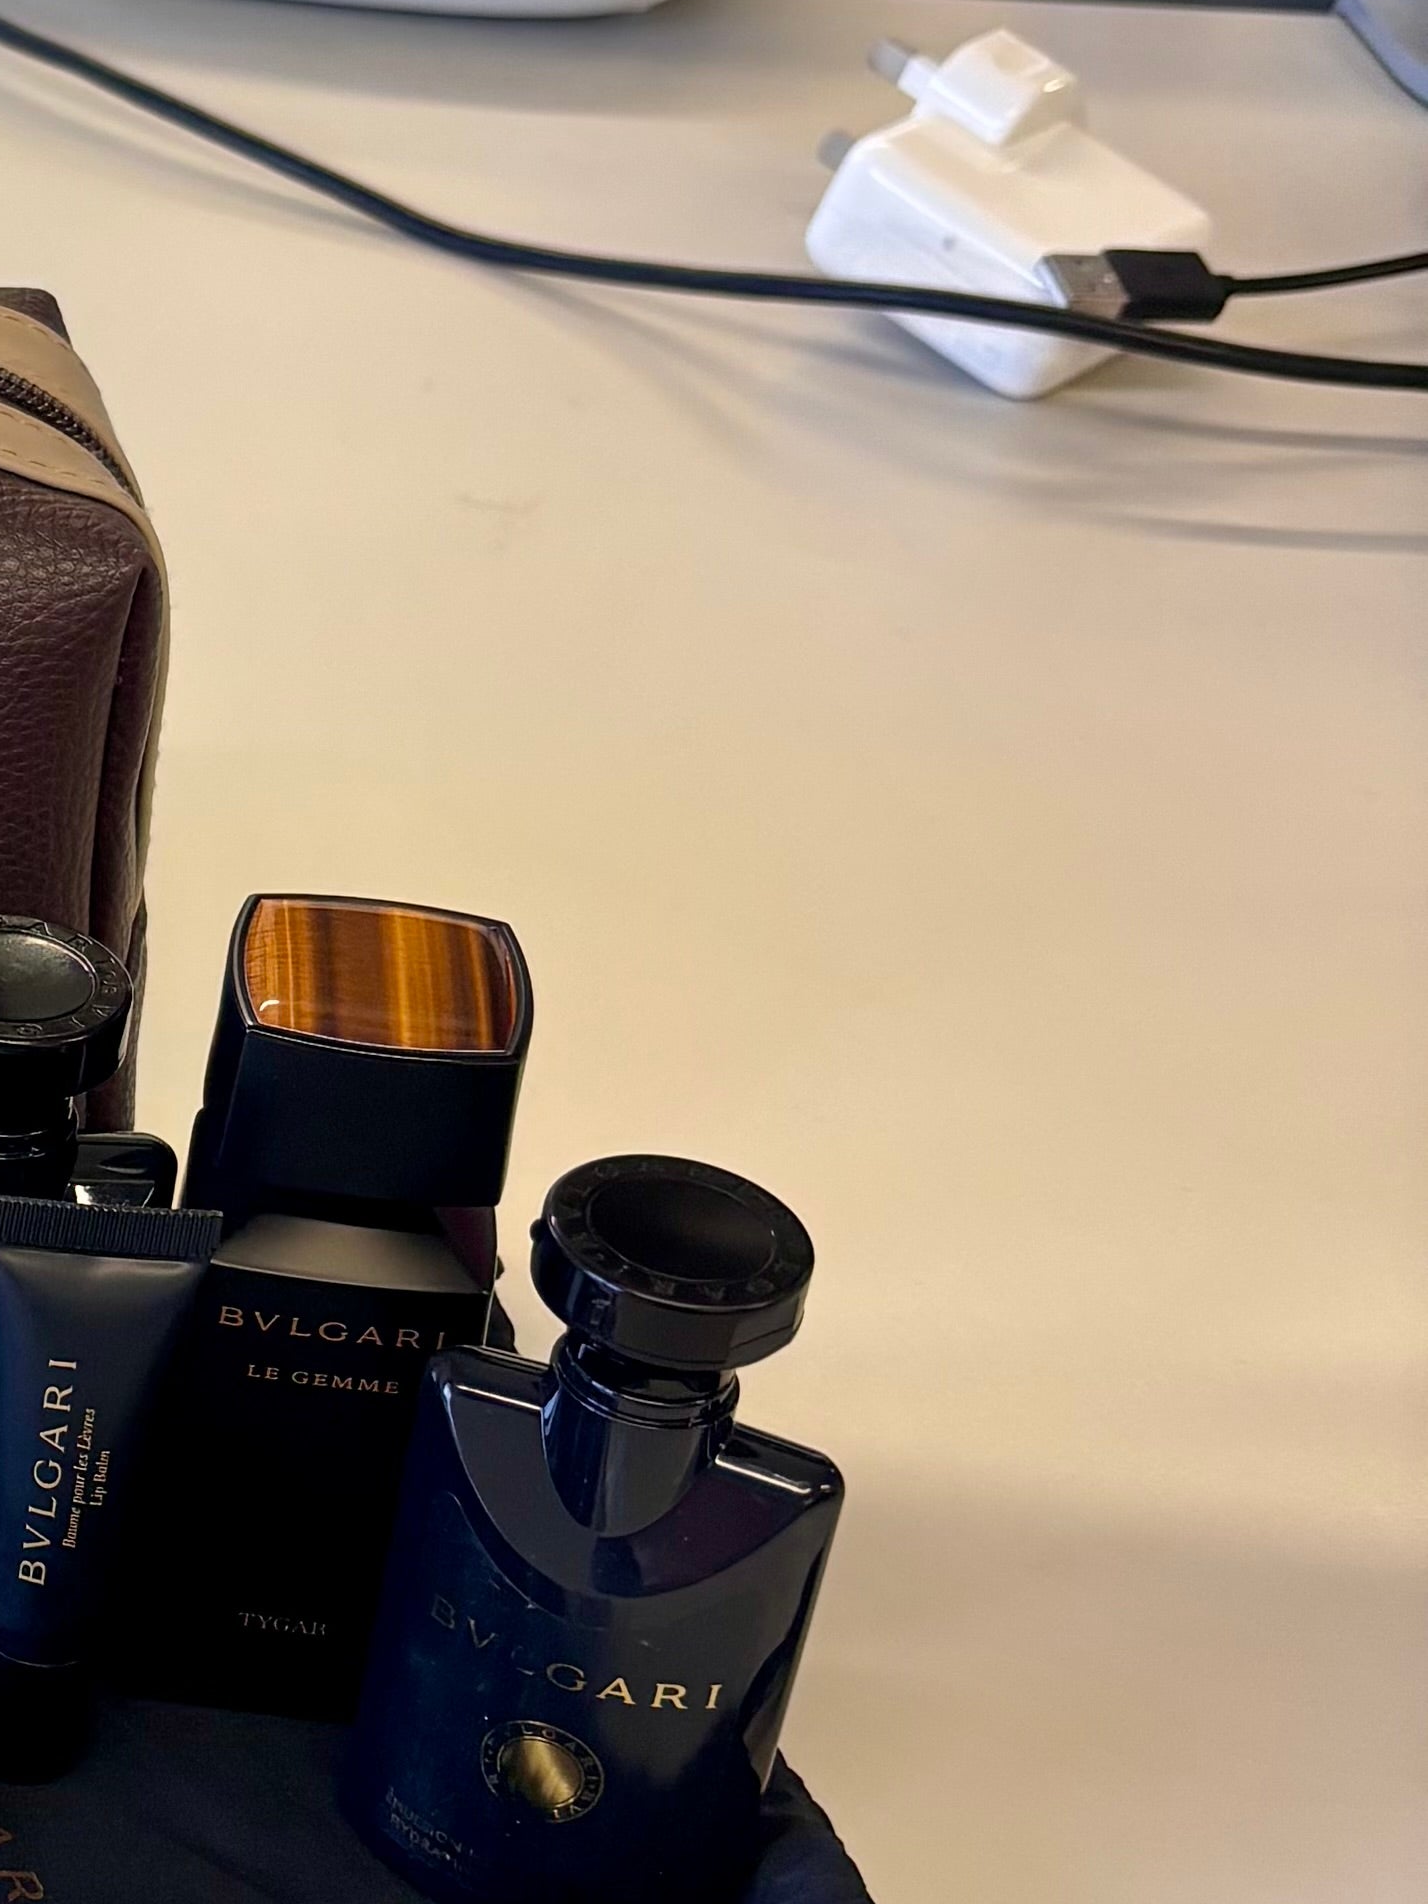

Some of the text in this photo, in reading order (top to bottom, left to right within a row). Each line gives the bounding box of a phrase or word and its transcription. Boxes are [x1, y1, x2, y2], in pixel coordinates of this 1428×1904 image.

[218, 1305, 448, 1352] BVLGARI
[245, 1363, 401, 1395] LE GEMME
[18, 1357, 79, 1587] BVLGARI
[74, 1450, 90, 1473] les
[88, 1450, 112, 1508] Lip Balm
[72, 1471, 86, 1508] pour
[61, 1506, 83, 1550] Baume
